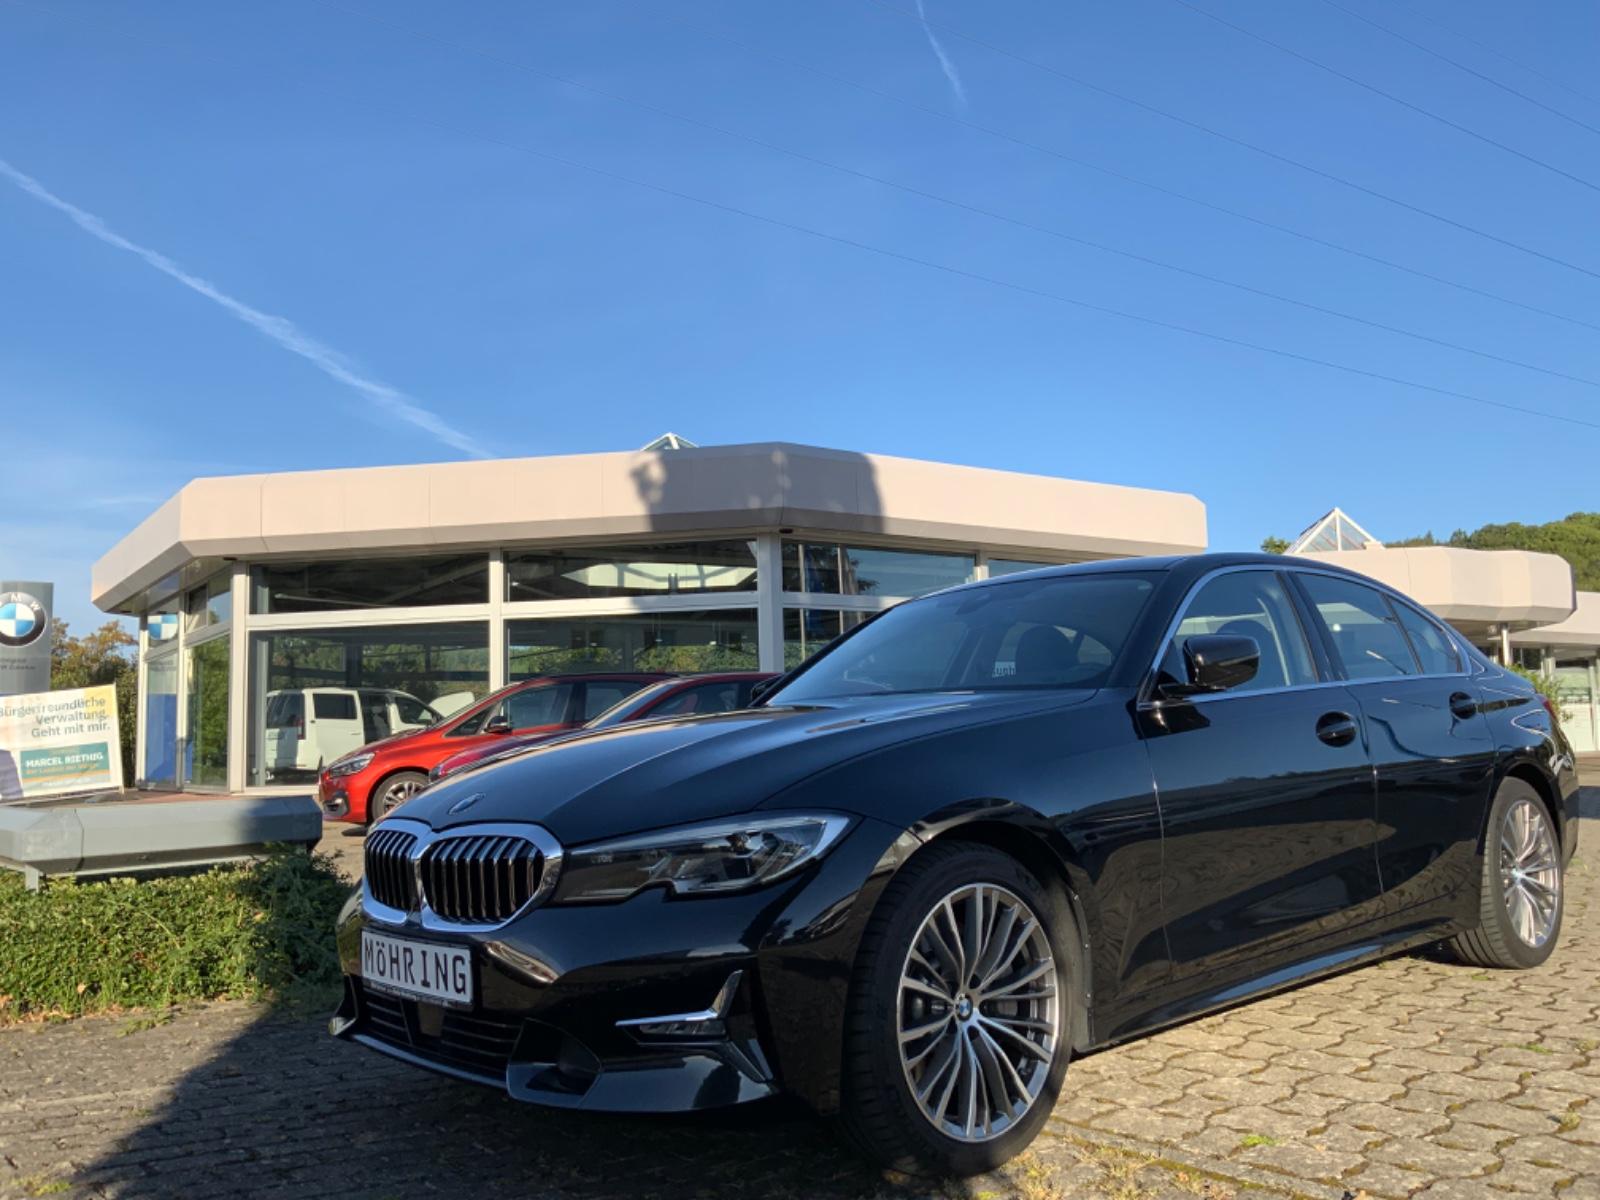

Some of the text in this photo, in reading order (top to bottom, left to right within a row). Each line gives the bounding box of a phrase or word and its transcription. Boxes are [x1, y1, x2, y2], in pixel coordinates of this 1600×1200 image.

[31, 721, 111, 737] Geht mit mir.
[26, 758, 63, 769] MARCEL
